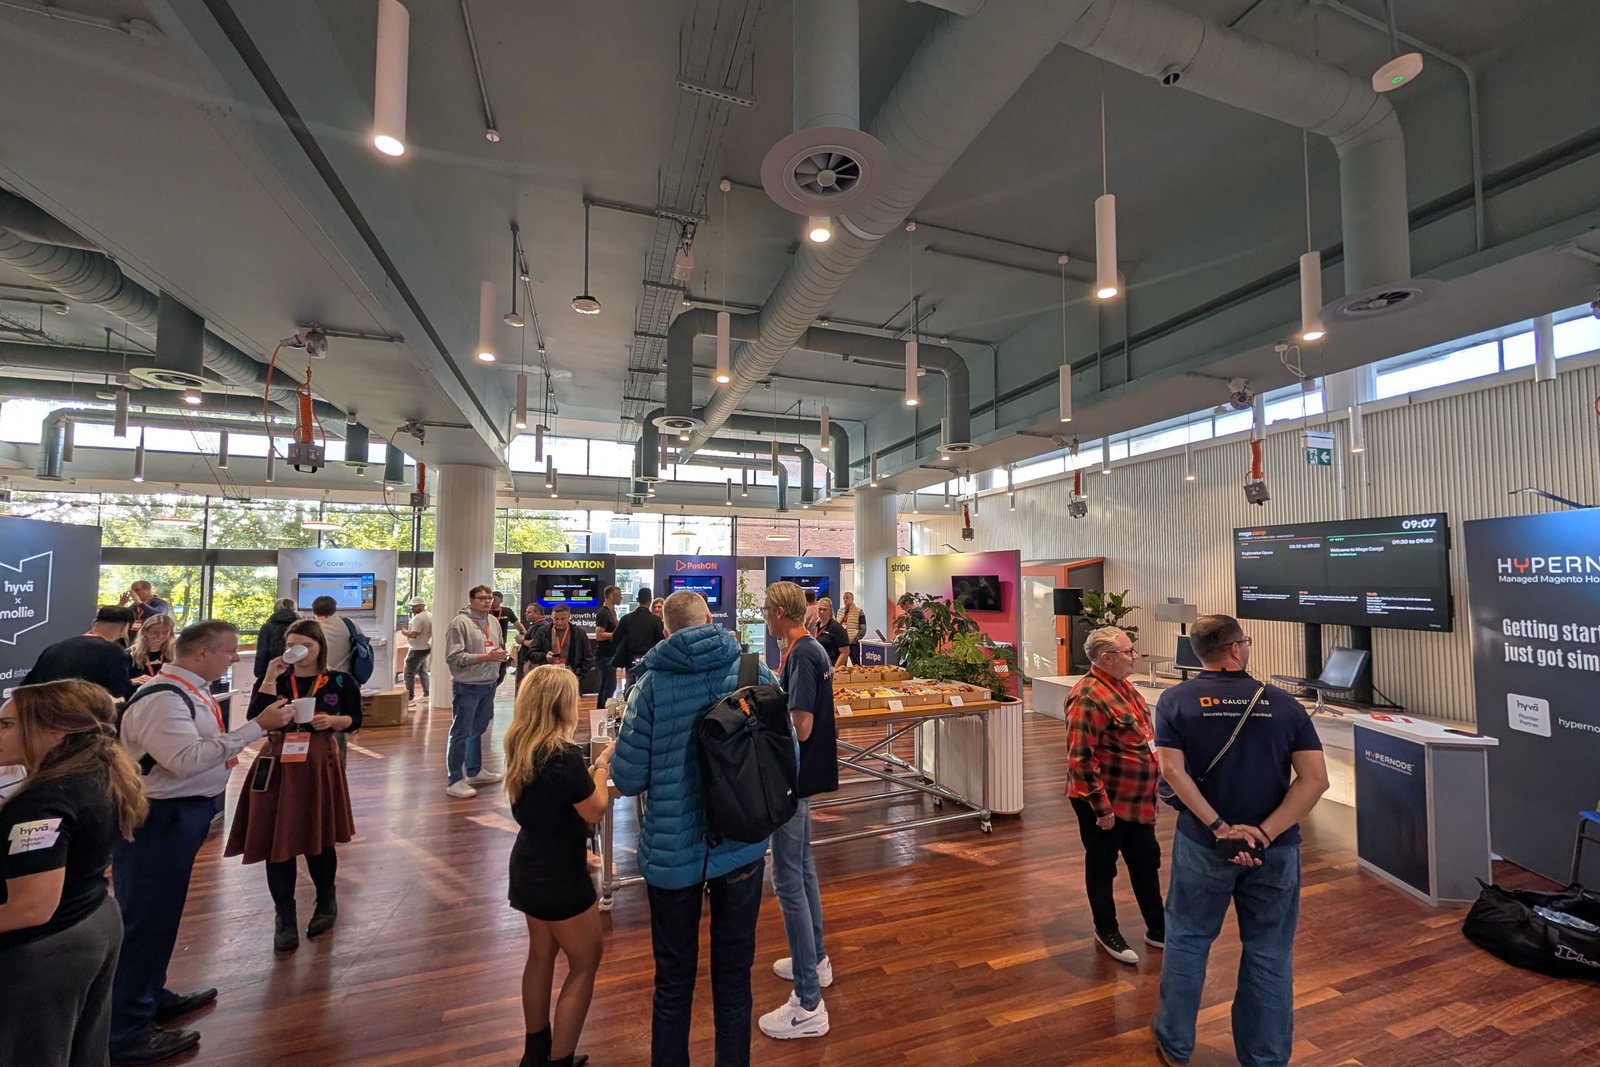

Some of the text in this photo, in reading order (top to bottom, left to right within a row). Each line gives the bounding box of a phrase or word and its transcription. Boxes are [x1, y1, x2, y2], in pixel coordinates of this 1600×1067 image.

[1402, 519, 1436, 529] 09:07
[533, 560, 605, 569] FOUNDATION
[687, 562, 718, 570] PushON
[891, 562, 910, 573] stripe
[1497, 555, 1600, 574] HYPERN
[1499, 575, 1538, 585] Managed
[1540, 575, 1583, 585] Magento
[4, 580, 34, 595] hyvä
[0, 606, 35, 619] mollie
[1502, 618, 1558, 642] Getting
[865, 651, 882, 662] stripe
[1504, 642, 1534, 663] just
[1537, 648, 1564, 667] got
[1517, 700, 1540, 712] hyvä
[1365, 749, 1413, 772] HYPERNODE
[19, 823, 49, 836] hyvä
